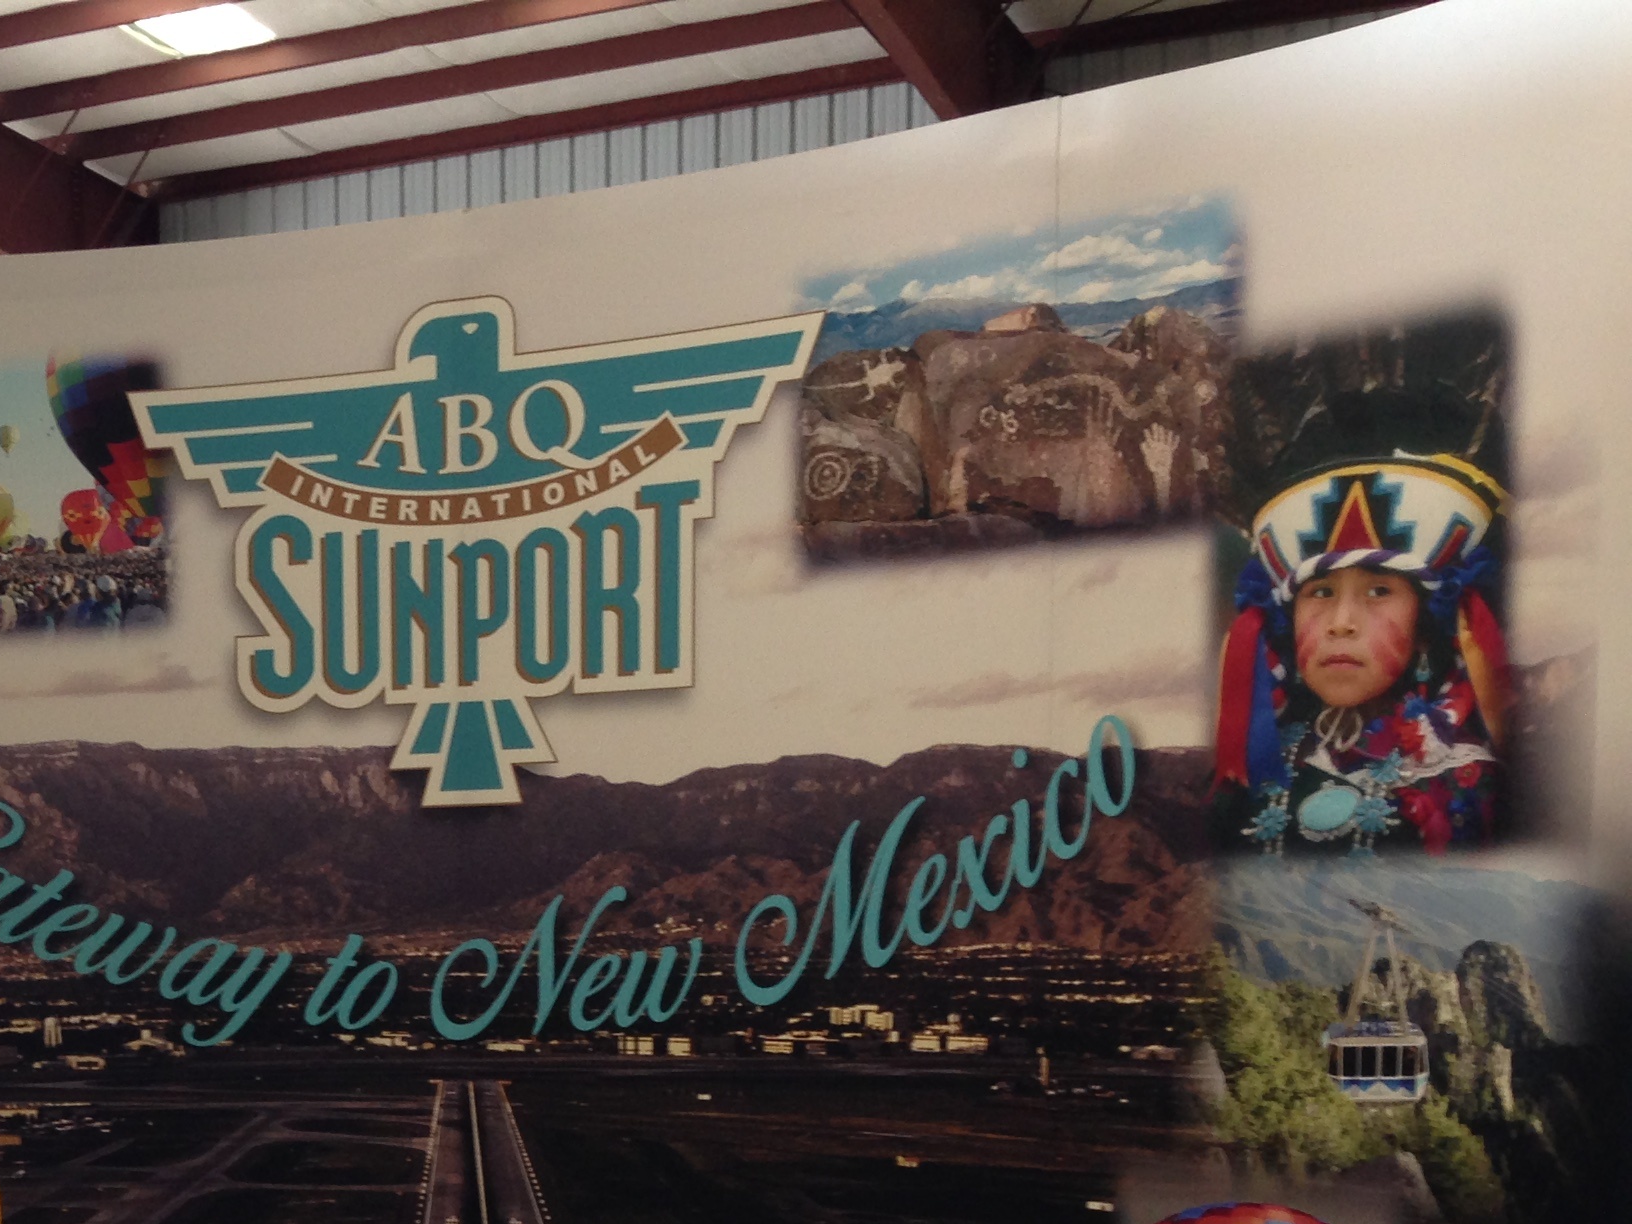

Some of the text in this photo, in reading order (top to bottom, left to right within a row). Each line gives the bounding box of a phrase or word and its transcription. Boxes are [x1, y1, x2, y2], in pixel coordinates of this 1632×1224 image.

[290, 441, 658, 522] INTERNATIONAL
[357, 378, 586, 476] ABQ
[249, 478, 701, 699] SUNPORT
[303, 934, 398, 1030] to
[429, 886, 703, 1041] New
[735, 714, 1136, 1006] Mexico
